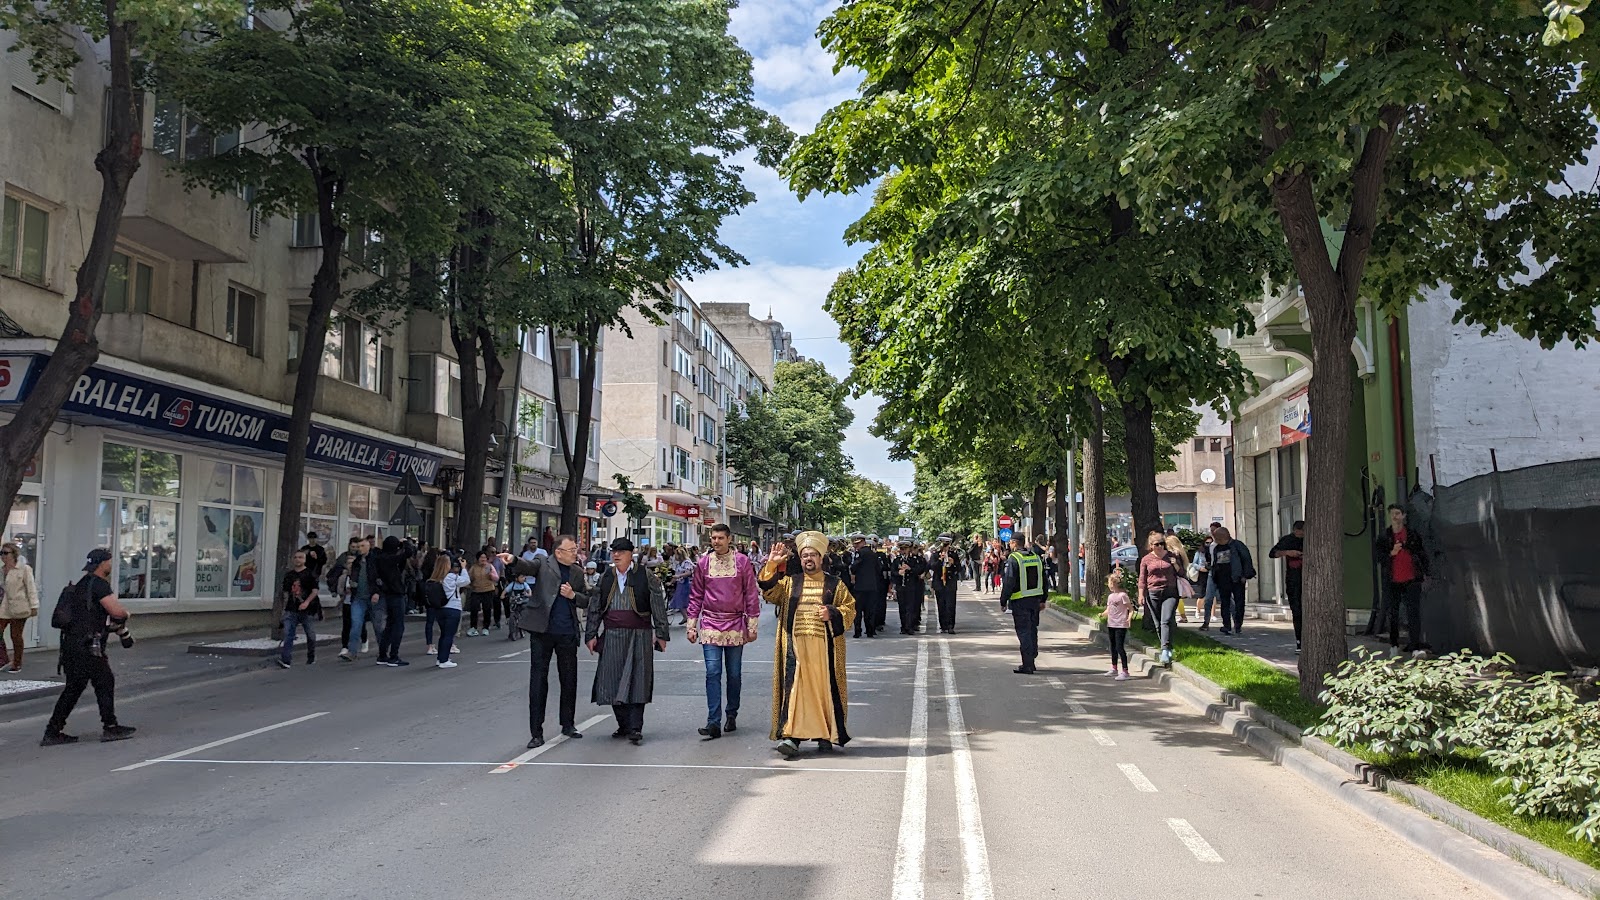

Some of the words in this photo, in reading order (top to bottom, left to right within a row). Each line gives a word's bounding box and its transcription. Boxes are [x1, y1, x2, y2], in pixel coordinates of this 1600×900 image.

[69, 375, 160, 419] RALELA
[195, 405, 265, 441] TURISM
[272, 430, 290, 440] FONDA
[314, 434, 379, 466] PARALELA
[396, 453, 436, 477] TURISM
[197, 573, 205, 582] DE
[207, 573, 212, 582] O
